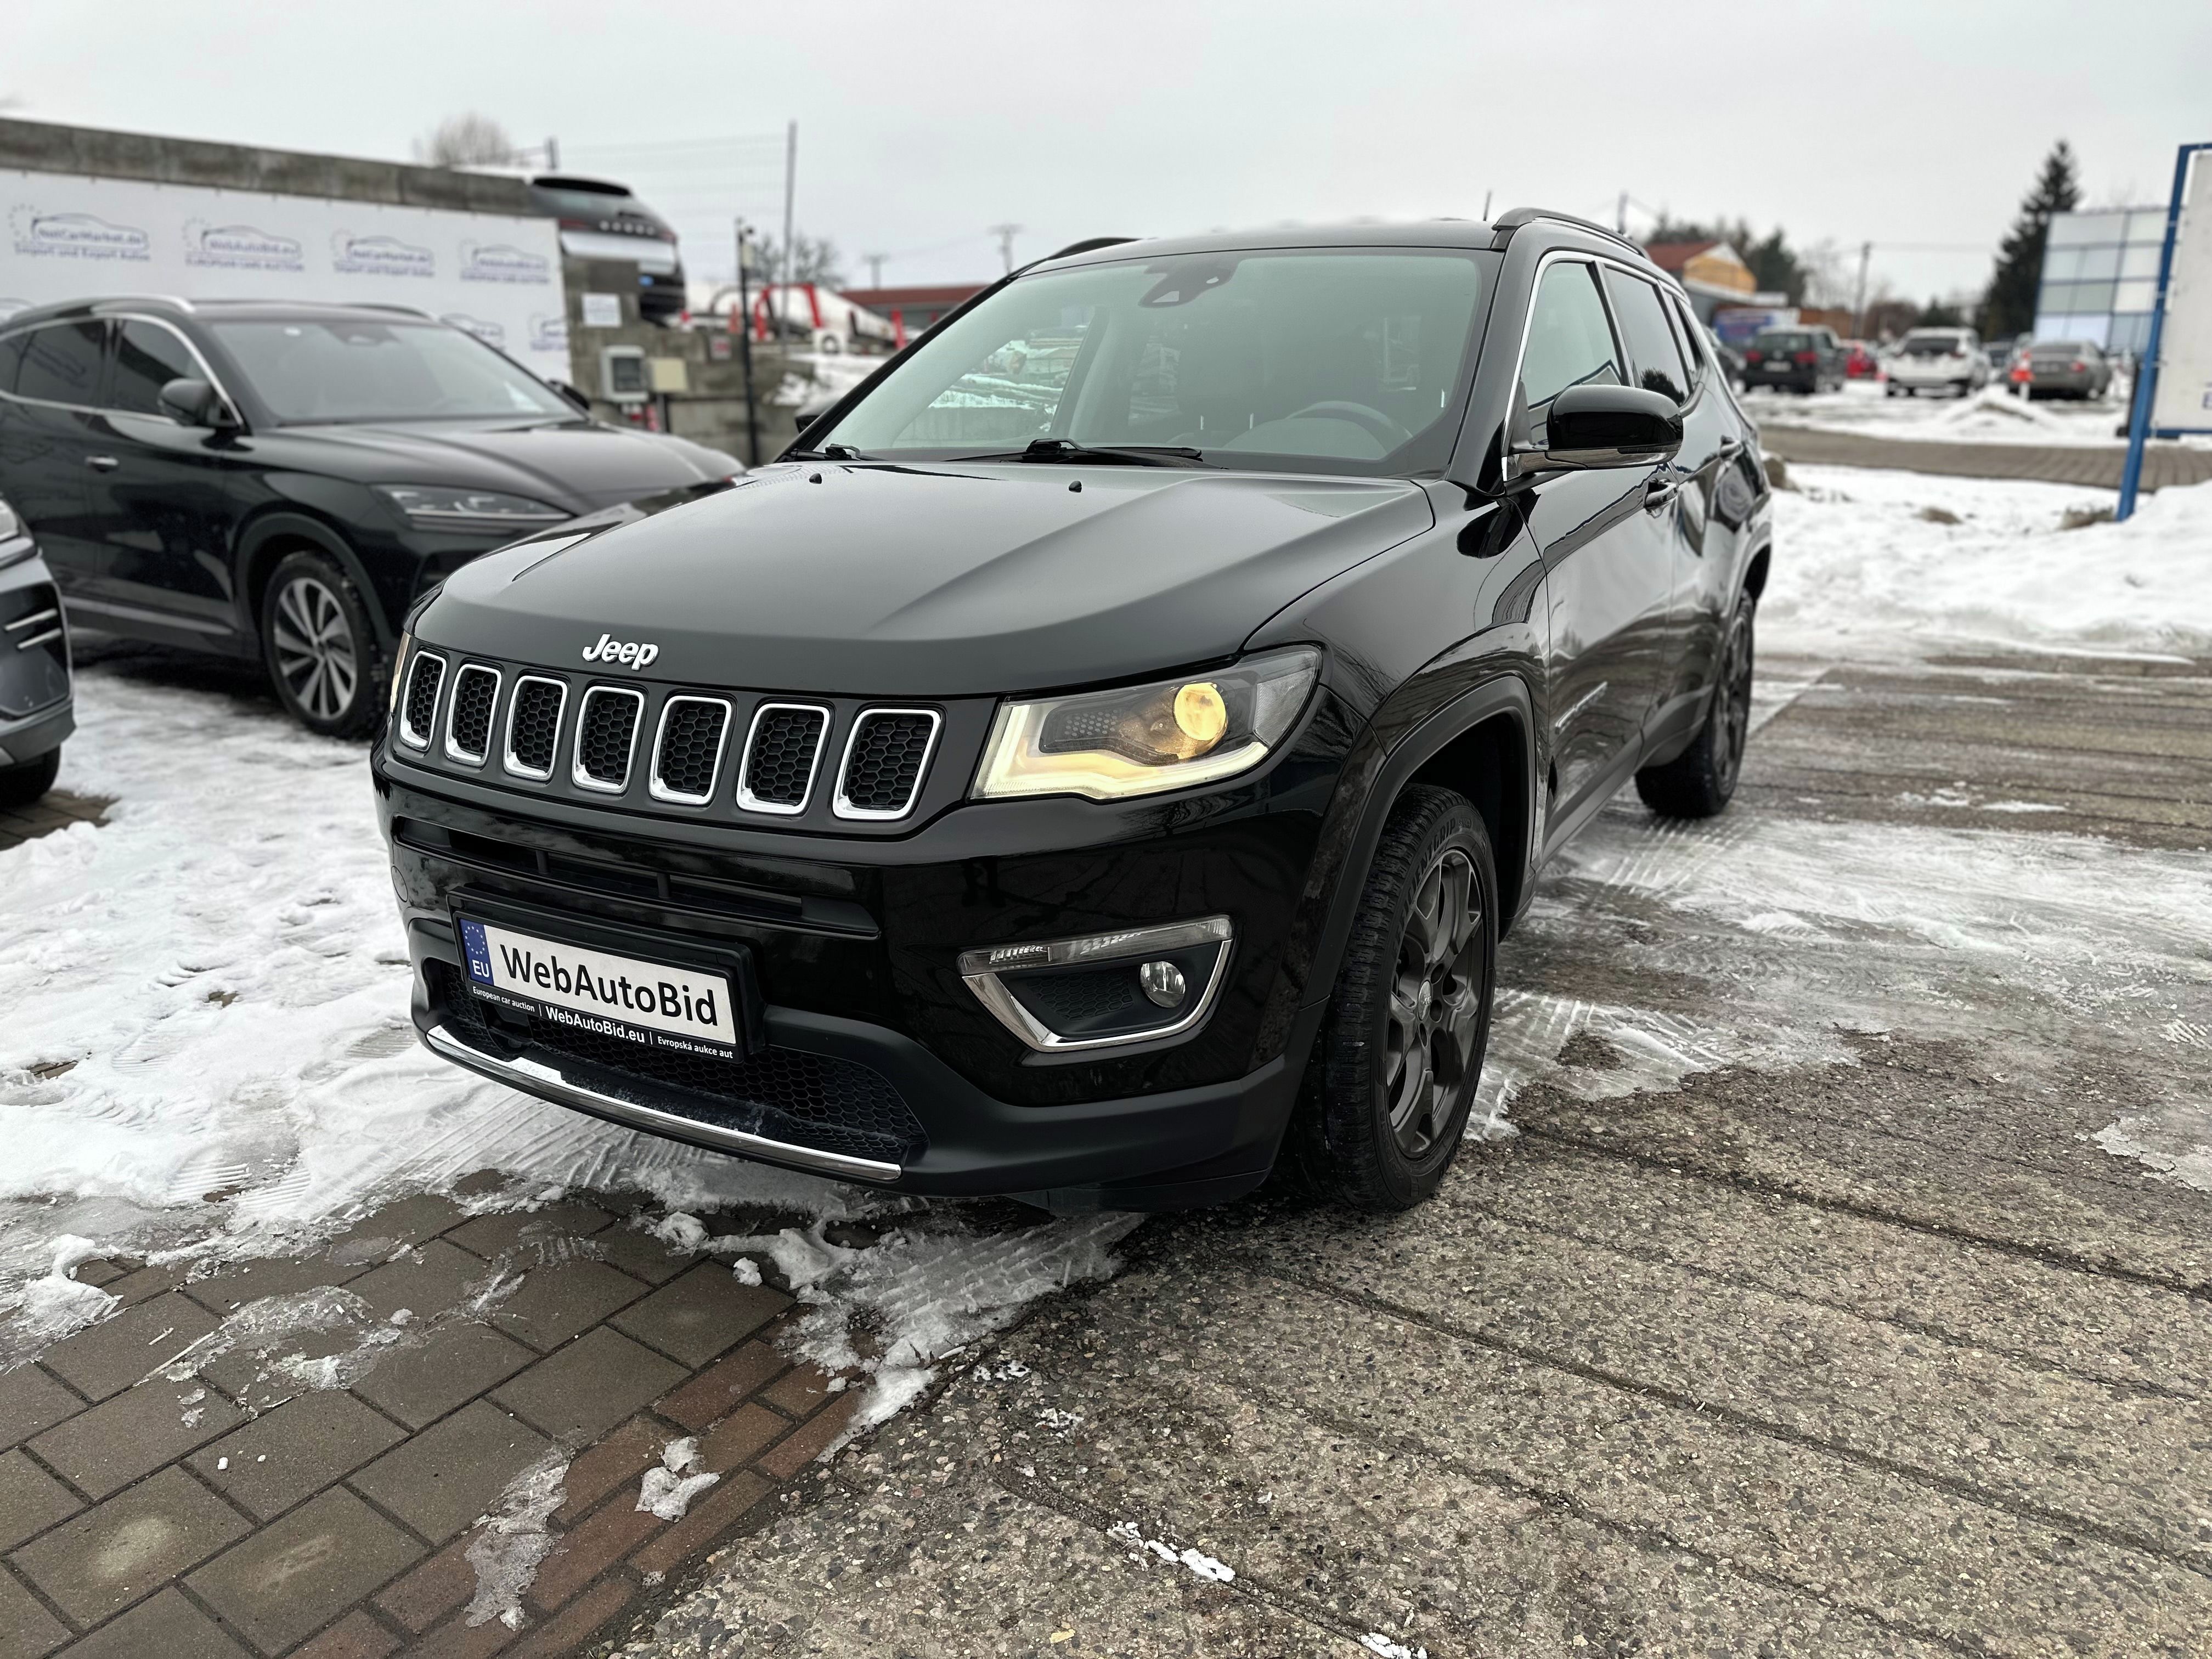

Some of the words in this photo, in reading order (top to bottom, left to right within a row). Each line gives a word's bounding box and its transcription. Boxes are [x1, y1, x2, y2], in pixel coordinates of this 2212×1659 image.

[582, 634, 659, 671] Jeep
[472, 959, 490, 978] EU
[500, 944, 718, 1026] WebAutoBid
[473, 986, 500, 1001] European
[501, 996, 511, 1005] car
[512, 1000, 535, 1012] auction
[545, 1006, 645, 1043] WebAutoBid.eu
[658, 1036, 692, 1051] Evropská
[694, 1045, 718, 1056] aukce
[719, 1050, 733, 1059] aut
